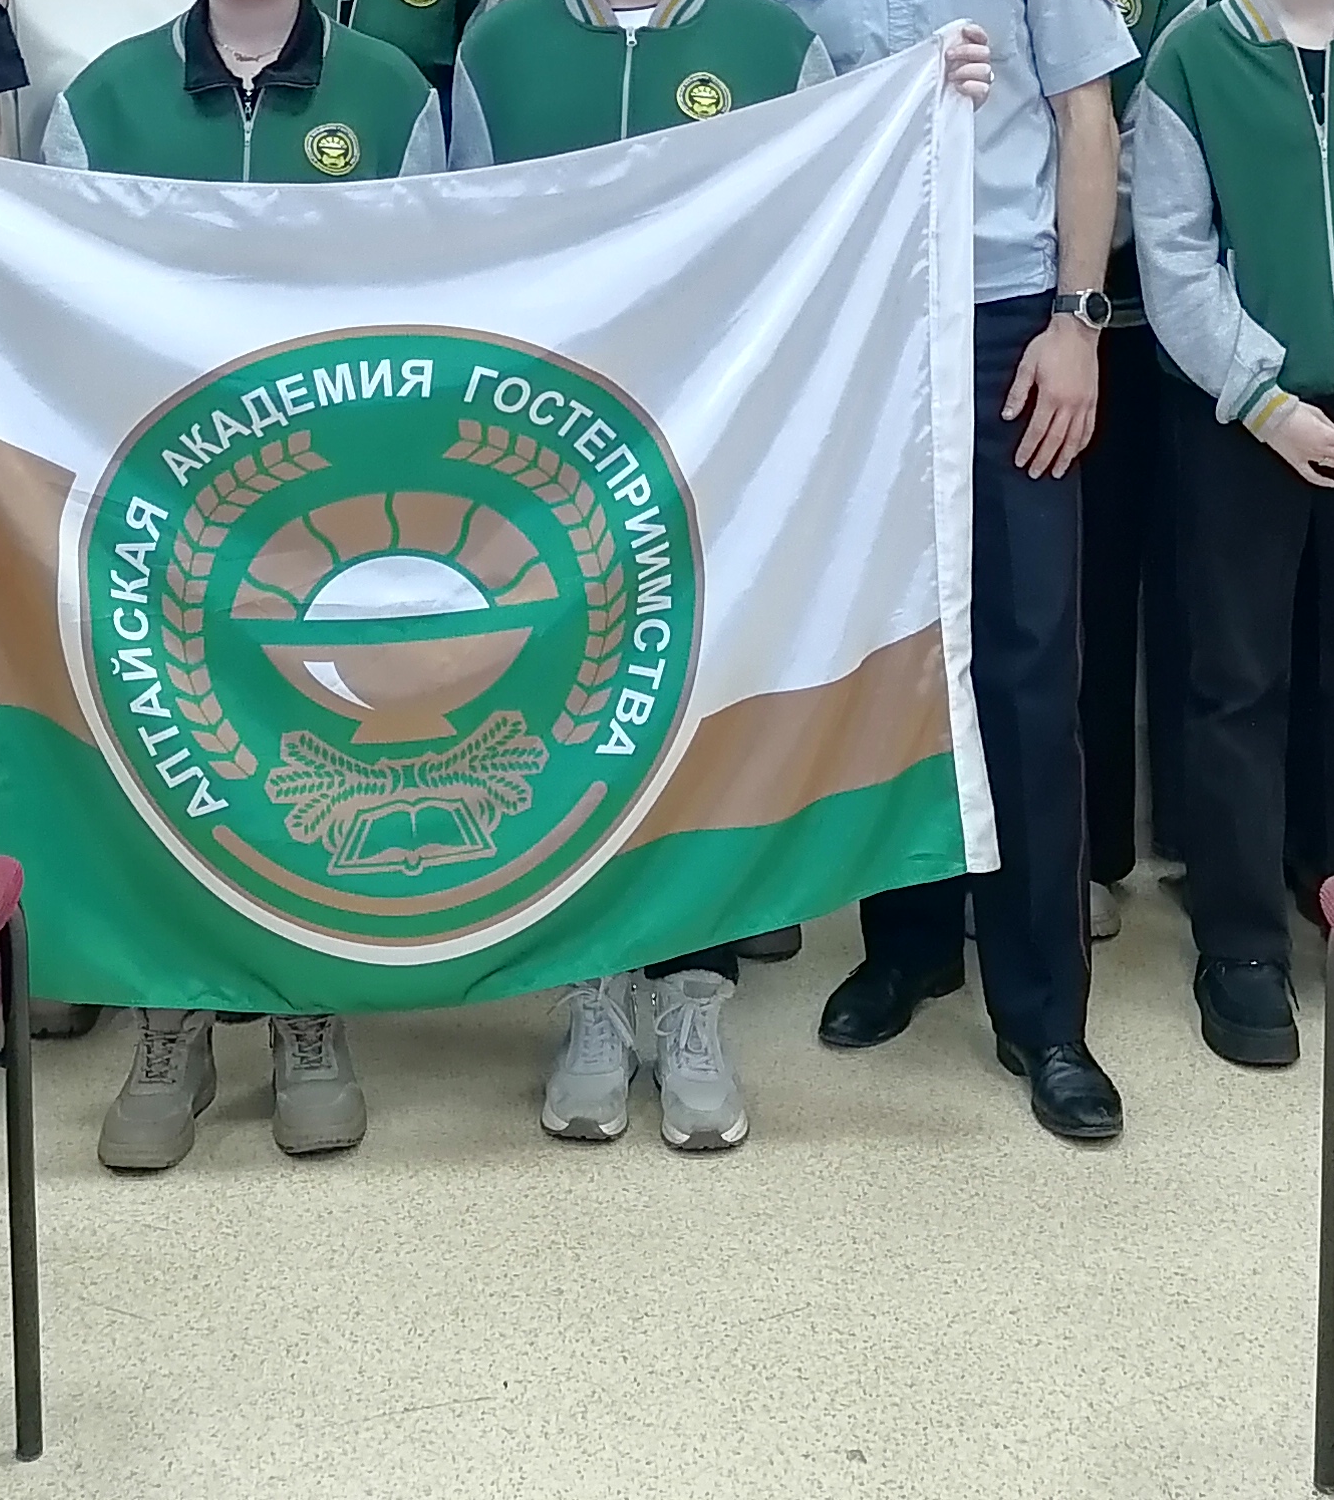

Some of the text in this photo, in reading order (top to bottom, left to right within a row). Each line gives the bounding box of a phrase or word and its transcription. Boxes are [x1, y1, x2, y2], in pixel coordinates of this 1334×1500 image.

[110, 359, 672, 817] АЛТАЙСКАЯ АКАДЕМИЯ ГОСТЕПРИИМСТВА
